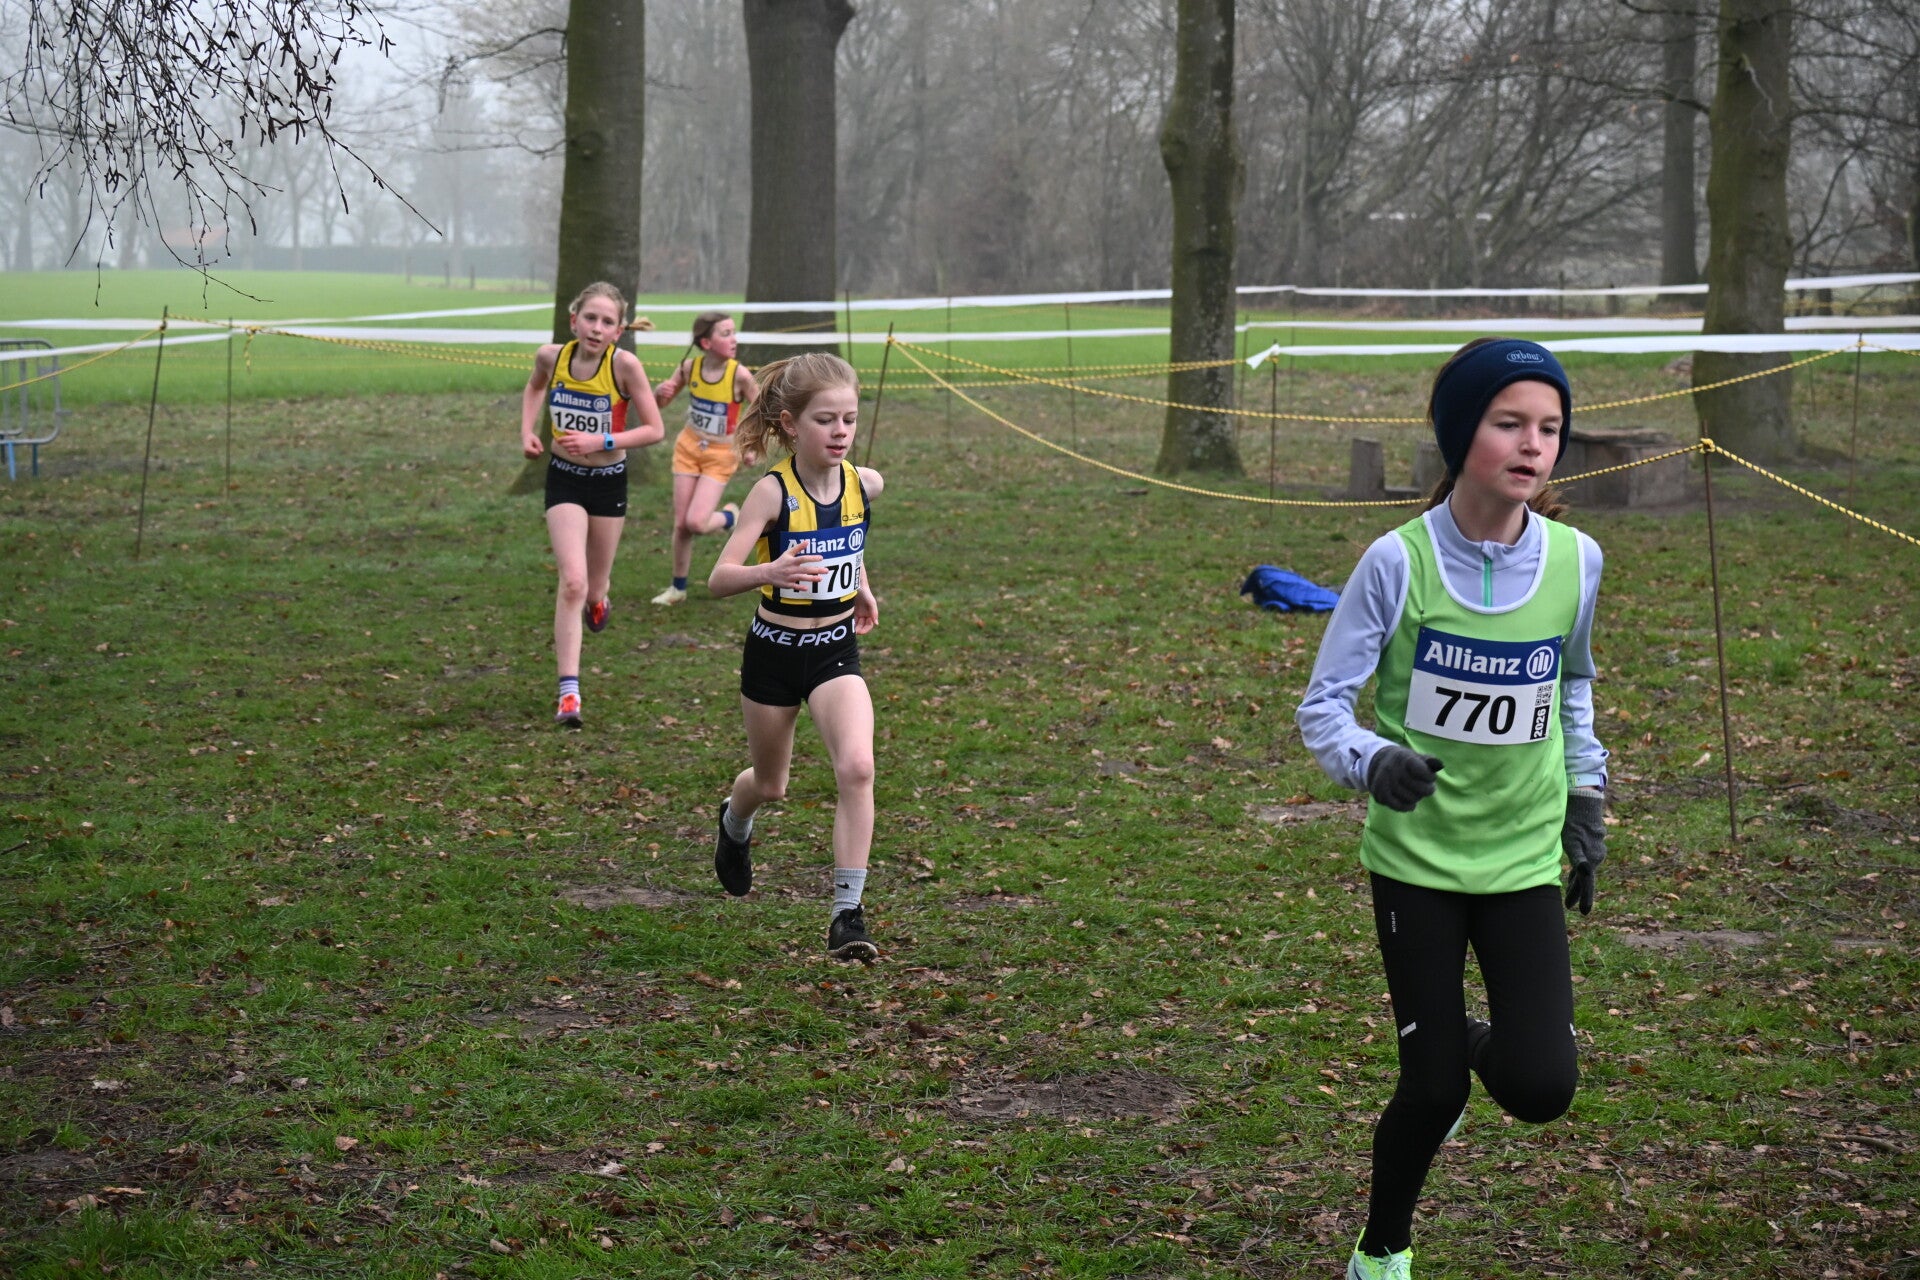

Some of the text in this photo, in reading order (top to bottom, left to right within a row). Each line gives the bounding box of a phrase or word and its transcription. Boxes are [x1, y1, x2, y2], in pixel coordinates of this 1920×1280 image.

[553, 393, 592, 409] Allianz
[555, 411, 598, 433] 1269
[552, 459, 625, 477] NIKE PRO
[751, 616, 796, 646] NIKE
[797, 625, 847, 647] PRO
[1423, 640, 1522, 676] Allianz
[1435, 686, 1517, 735] 770
[1533, 708, 1547, 738] 2026
